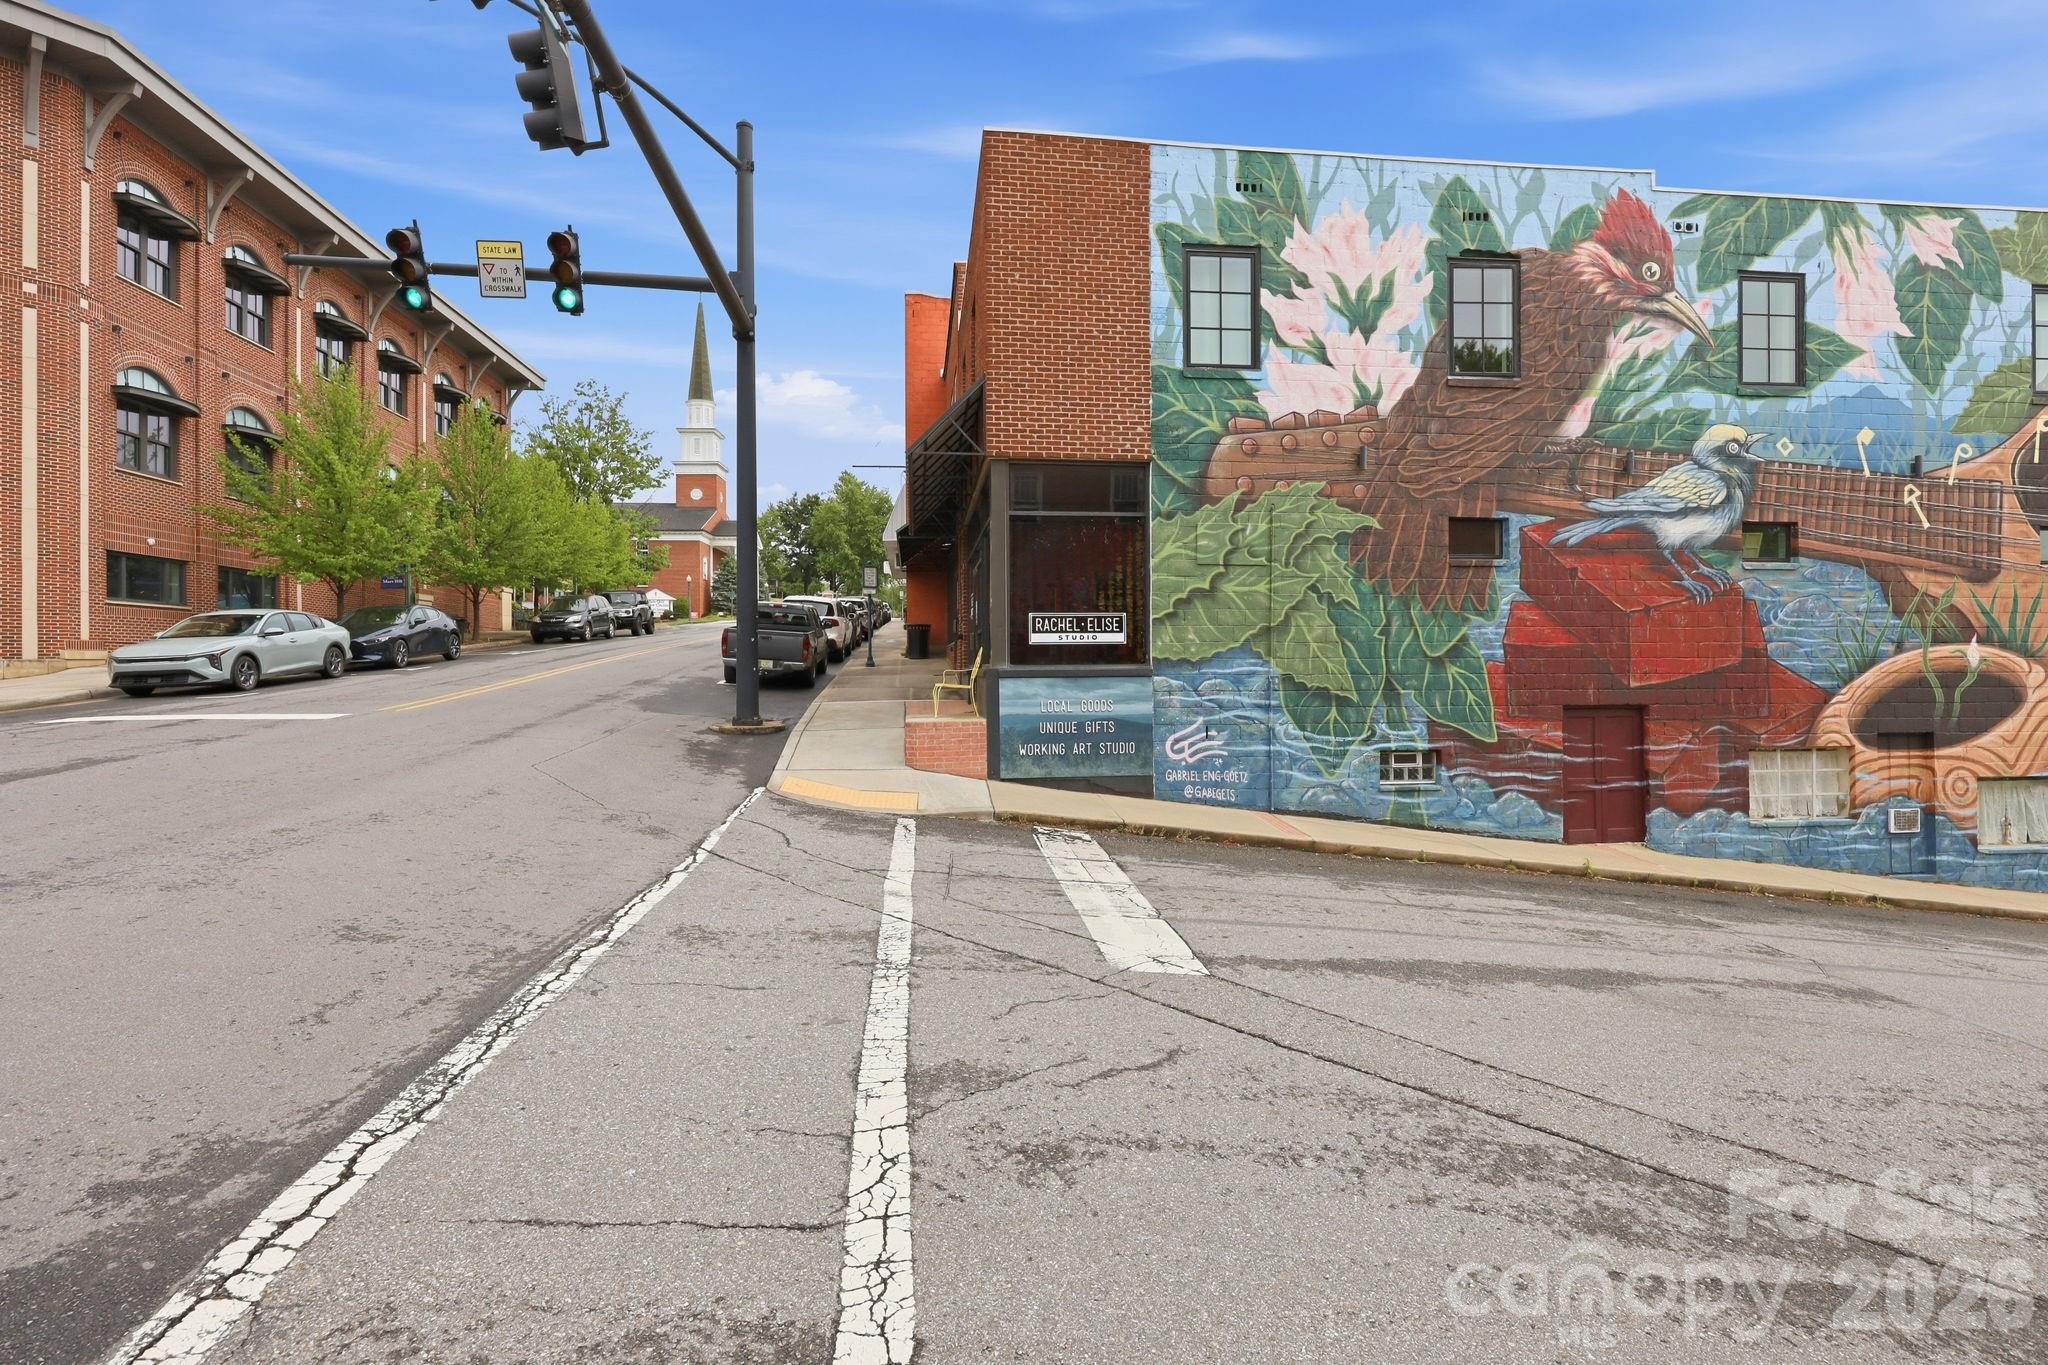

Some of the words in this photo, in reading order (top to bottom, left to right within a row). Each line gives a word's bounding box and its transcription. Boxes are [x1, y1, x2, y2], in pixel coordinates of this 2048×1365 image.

[482, 246, 501, 254] STATE
[484, 285, 522, 293] CROSSWALK
[1035, 617, 1081, 631] RACHEL
[1087, 617, 1120, 631] ELISE
[1040, 699, 1073, 713] LOCAL
[1080, 699, 1114, 712] GOODS
[1039, 721, 1078, 735] UNIQUE
[1085, 721, 1115, 733] GIFTS
[1018, 743, 1066, 756] WORKING
[1072, 743, 1092, 754] ART
[1099, 742, 1136, 754] STUDIO
[1165, 769, 1200, 782] GABRIEL
[1202, 770, 1248, 783] ENG-GOETZ
[1184, 784, 1235, 801] @GABEGETS
